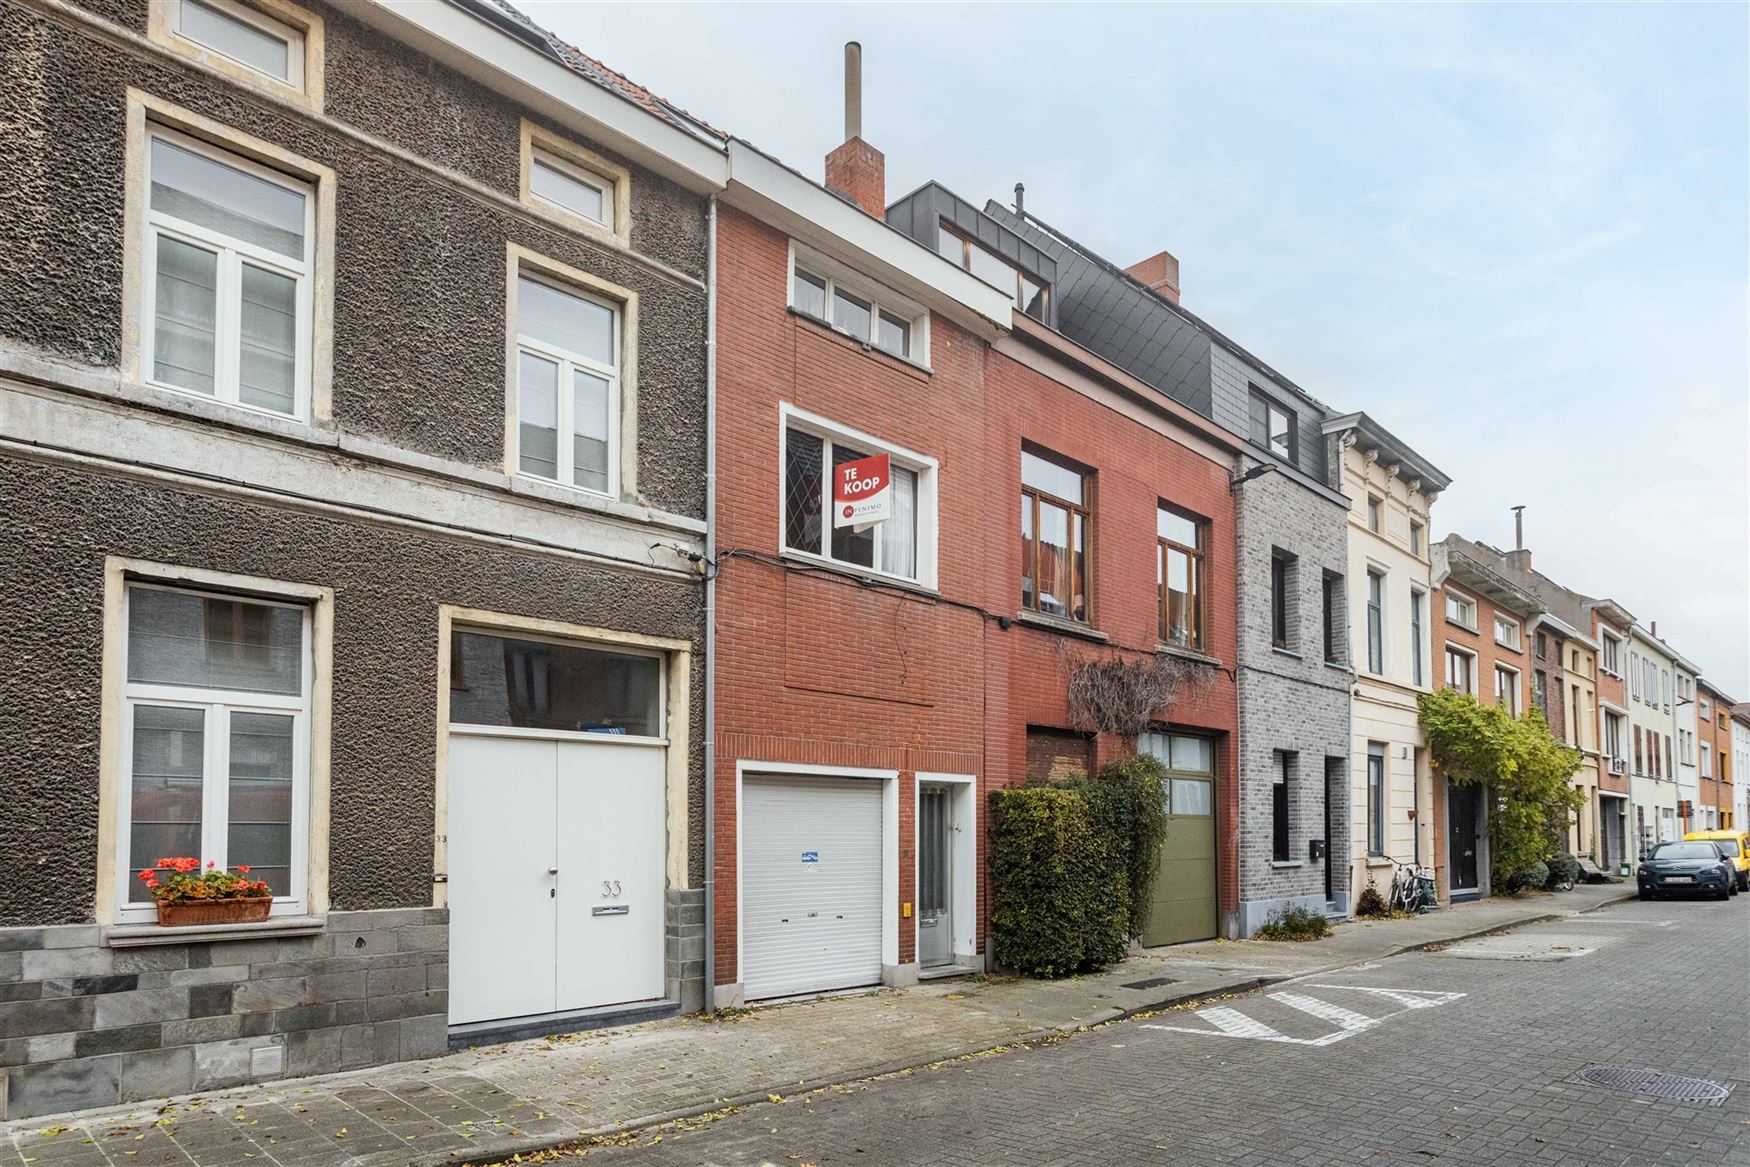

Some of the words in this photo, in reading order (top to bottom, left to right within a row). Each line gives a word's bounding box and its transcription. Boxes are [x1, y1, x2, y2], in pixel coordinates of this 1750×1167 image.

[844, 468, 857, 481] TE
[844, 476, 880, 495] KOOP
[436, 834, 447, 843] 33
[601, 880, 622, 897] 33
